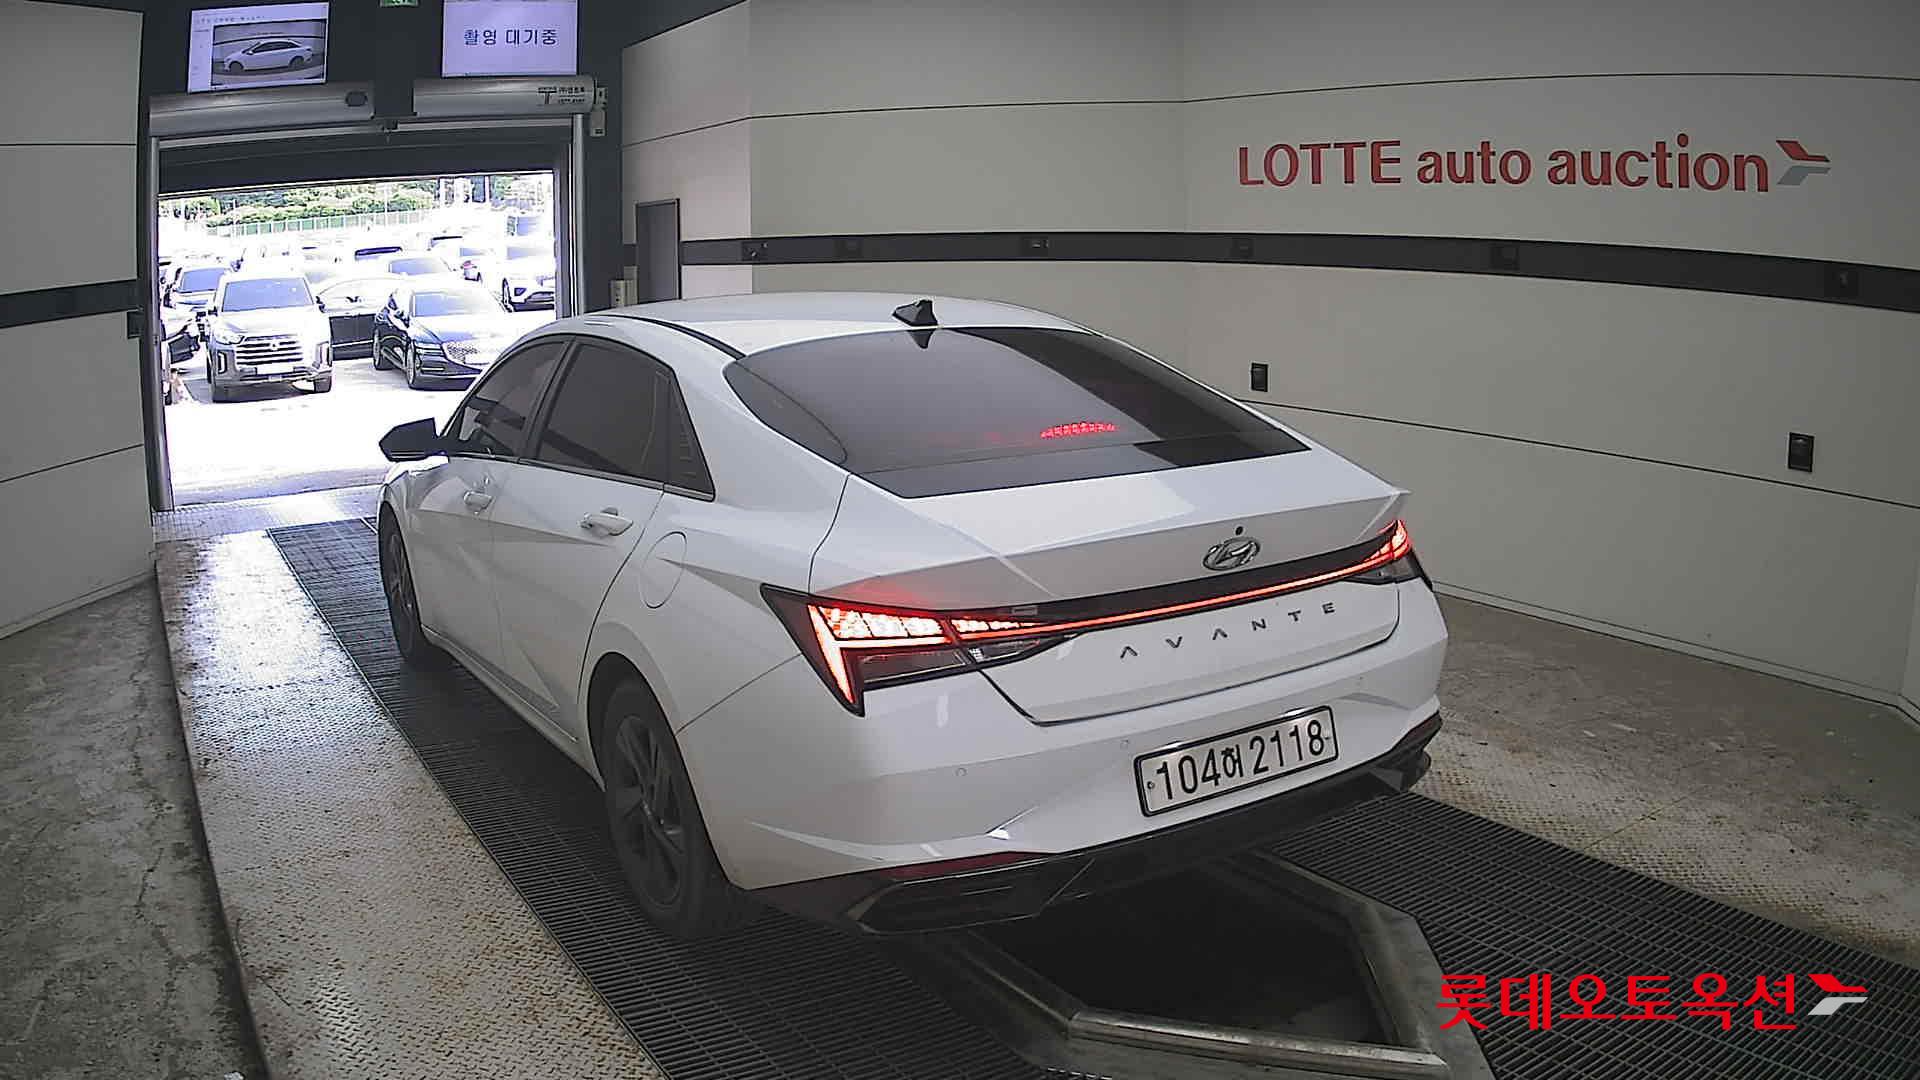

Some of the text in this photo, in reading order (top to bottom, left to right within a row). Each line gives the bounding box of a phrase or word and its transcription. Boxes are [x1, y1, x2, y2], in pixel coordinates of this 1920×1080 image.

[464, 29, 557, 46] 촬영 대기중
[1239, 133, 1769, 192] LOTTE auto auction
[1120, 602, 1336, 659] AVANTE
